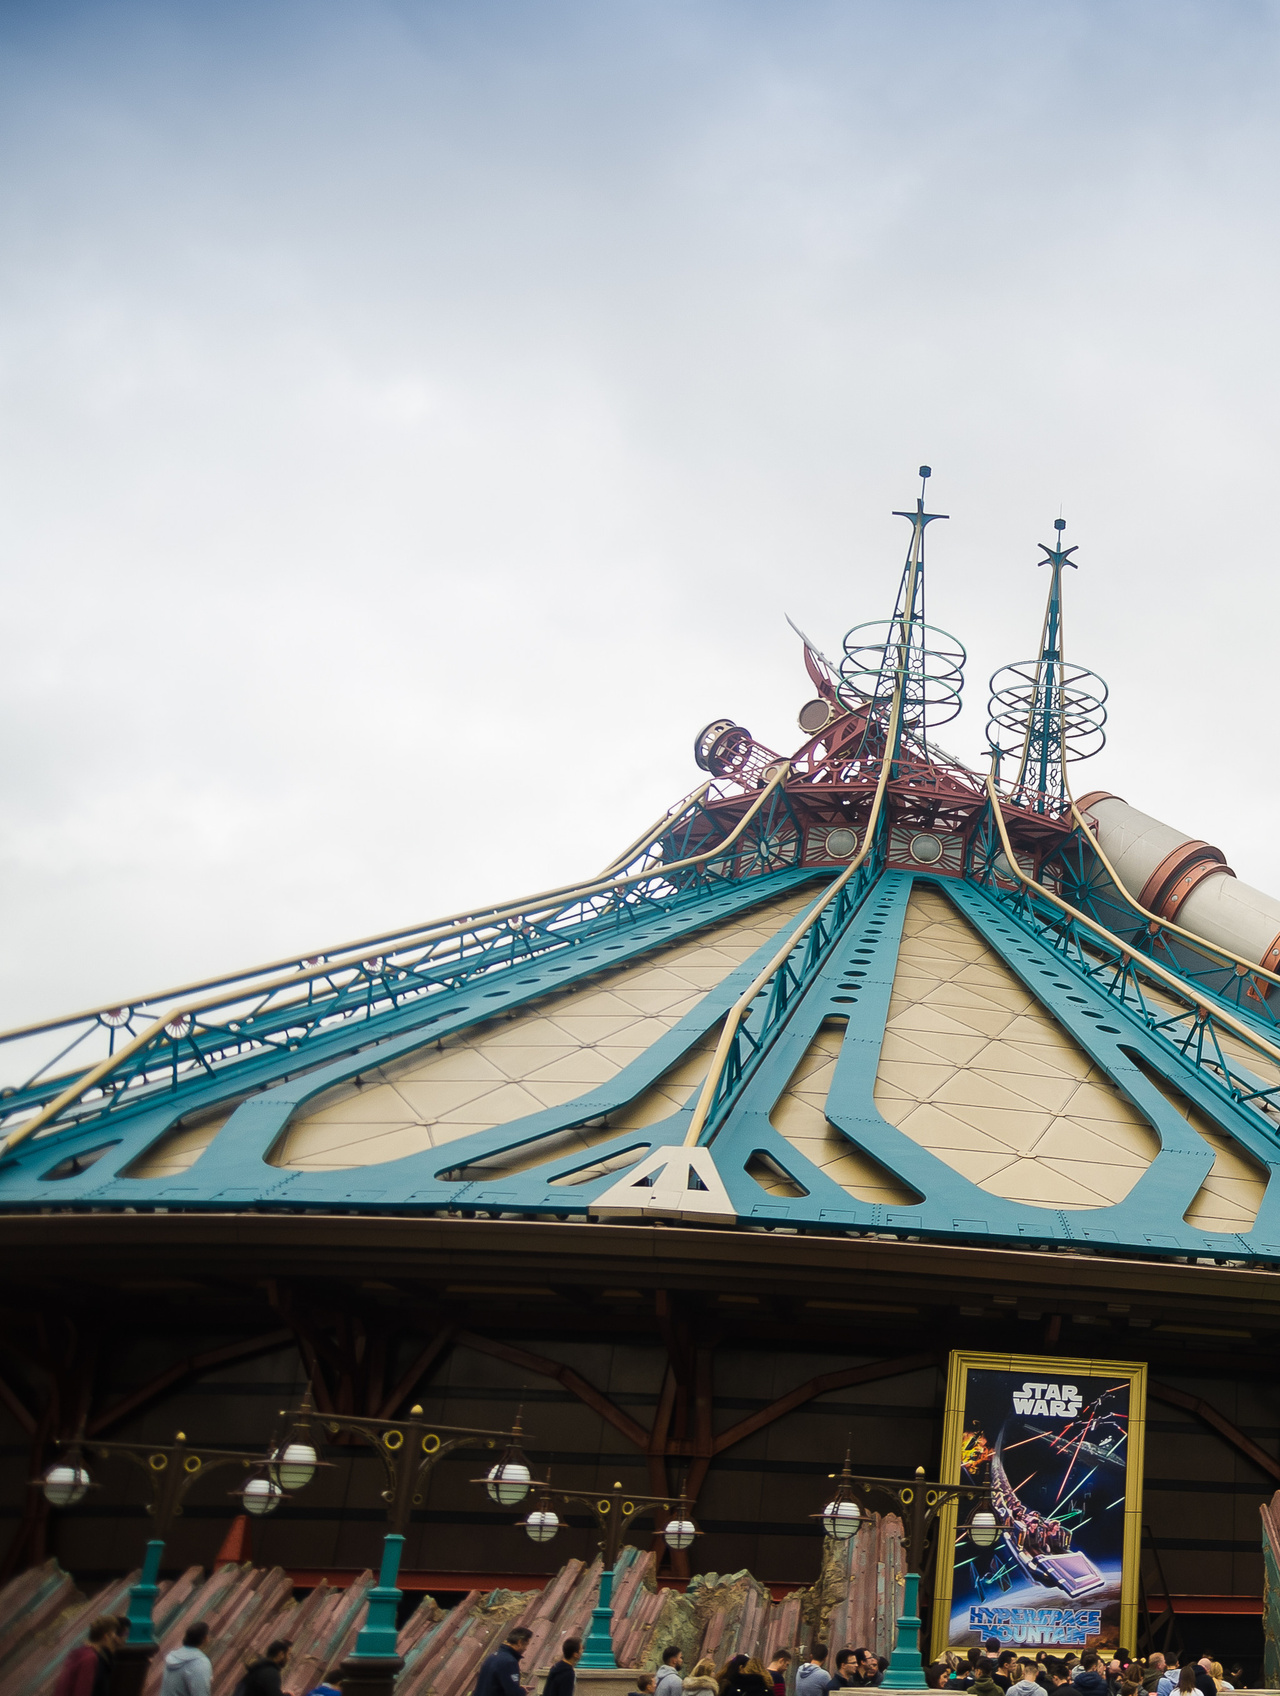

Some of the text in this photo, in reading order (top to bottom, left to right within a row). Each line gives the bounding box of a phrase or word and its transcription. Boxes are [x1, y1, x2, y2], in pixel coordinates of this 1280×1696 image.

[1013, 1382, 1083, 1402] STAR
[1013, 1398, 1083, 1418] WARS
[969, 1605, 1101, 1627] HYPERSPACE
[968, 1624, 1100, 1644] MOUNTAIN
